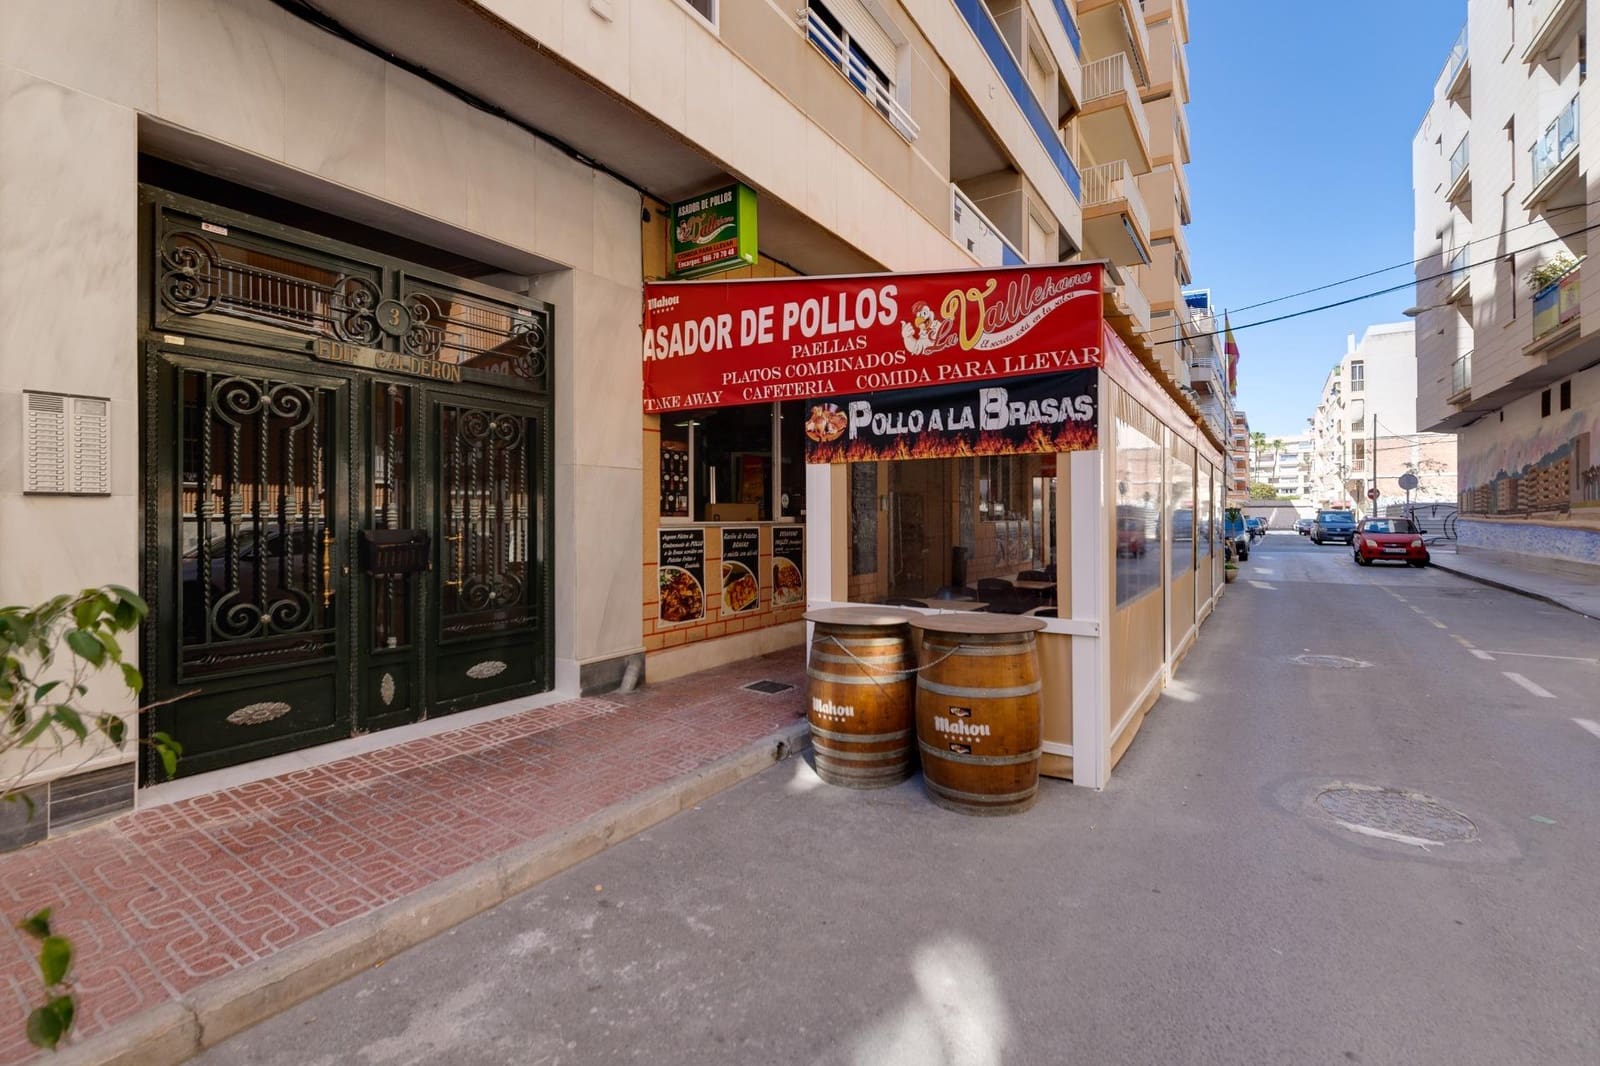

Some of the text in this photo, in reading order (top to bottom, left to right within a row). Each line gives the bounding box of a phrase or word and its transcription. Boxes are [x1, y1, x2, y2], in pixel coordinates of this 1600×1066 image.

[678, 191, 732, 217] ASADOR DE POLLOS
[388, 308, 400, 326] 3
[648, 296, 680, 310] Mahou
[643, 284, 898, 361] ASADOR DE POLLOS
[924, 319, 960, 355] La
[792, 335, 867, 359] PAELLAS
[374, 351, 462, 383] CALDERON
[643, 346, 1101, 411] TAKE AWAY CAFETERIA COMIDA PARA LLEVAR
[722, 350, 906, 385] PLATOS COMBINADOS
[849, 387, 1093, 440] POLLO A LA BRASAS
[812, 697, 854, 717] Mahou
[934, 715, 990, 737] Mahou
